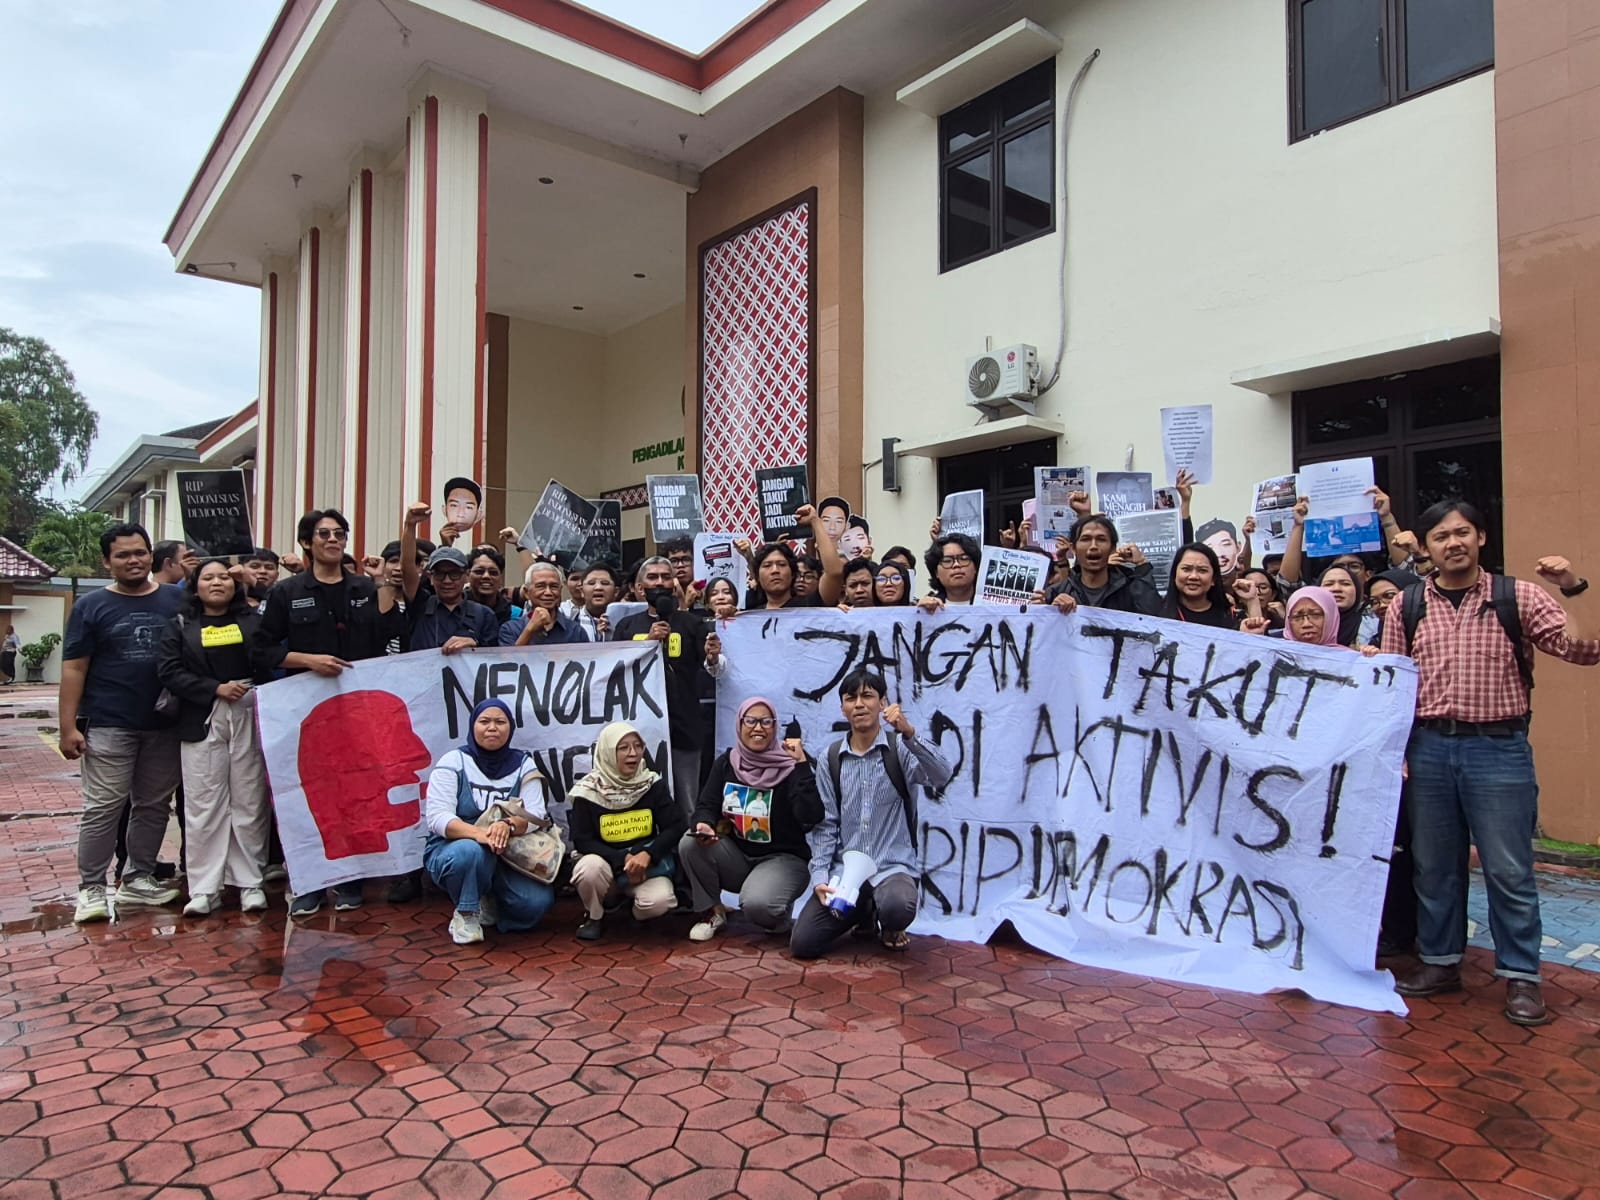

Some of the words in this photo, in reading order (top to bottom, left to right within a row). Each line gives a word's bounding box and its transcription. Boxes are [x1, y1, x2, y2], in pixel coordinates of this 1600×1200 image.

[185, 481, 204, 492] RIP
[761, 477, 794, 492] JANGAN
[551, 489, 568, 502] RIP
[653, 485, 686, 496] JANGAN
[654, 496, 680, 507] TAKUT
[762, 489, 788, 504] TAKUT
[1103, 494, 1127, 503] KAMI
[187, 507, 240, 518] DEMOCRACY
[764, 503, 782, 517] JADI
[1103, 503, 1146, 512] MENAGIH
[656, 508, 674, 519] JADI
[657, 518, 690, 530] AKTIVIS
[766, 514, 797, 529] AKTIVIS
[602, 819, 628, 828] JANGAN
[630, 815, 650, 823] TAKUT
[623, 825, 648, 833] AKTIVIS
